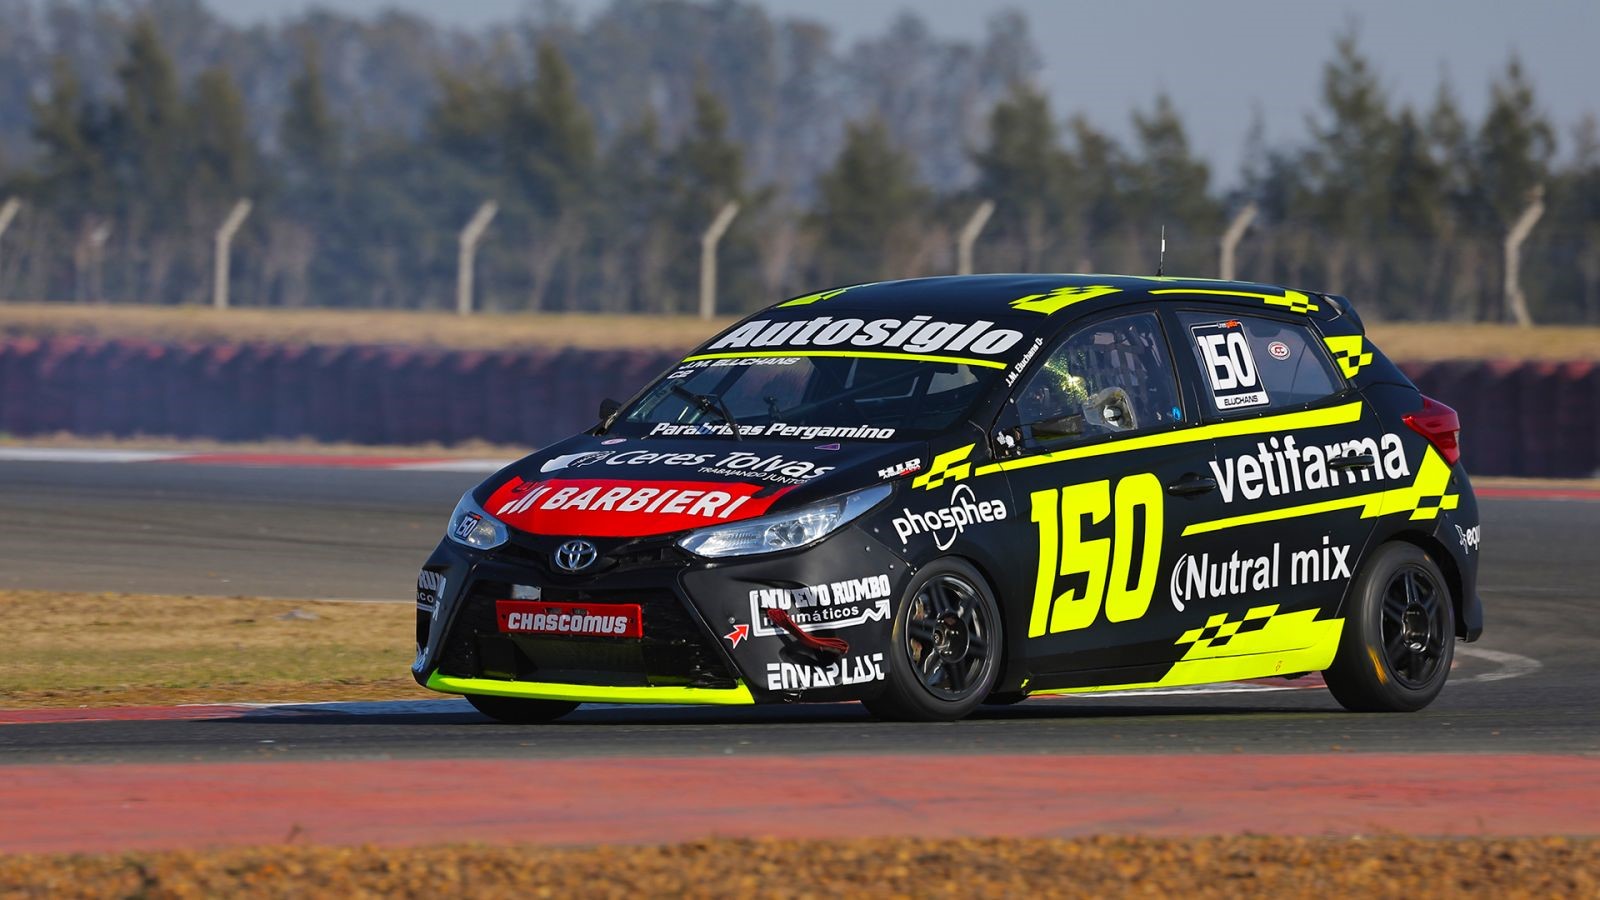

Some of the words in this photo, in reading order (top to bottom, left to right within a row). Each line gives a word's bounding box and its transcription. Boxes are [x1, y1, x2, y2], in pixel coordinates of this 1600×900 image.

[707, 315, 1024, 355] Autosiglo
[711, 357, 801, 367] ELUCHANS
[1005, 371, 1019, 388] J.M.
[1014, 343, 1040, 374] Eluchans
[1197, 332, 1256, 391] 150
[1224, 395, 1259, 407] ELUCHANS
[649, 422, 767, 436] Parabrisas
[763, 423, 896, 440] Pergamino
[605, 450, 717, 466] Ceres
[715, 451, 836, 480] Tolvas
[697, 466, 767, 478] TRABAJANDO
[1208, 433, 1411, 504] vetifarma
[540, 486, 751, 519] BARBIERI
[892, 496, 1007, 545] phosphea
[455, 515, 478, 538] 150
[1028, 472, 1164, 639] 150
[1185, 542, 1280, 601] Nutral
[1291, 535, 1351, 586] mix
[760, 583, 832, 611] NUEVO
[830, 574, 891, 606] RUMBO
[508, 612, 628, 634] CHASCOMUS
[766, 652, 885, 692] ENVAPLAST
